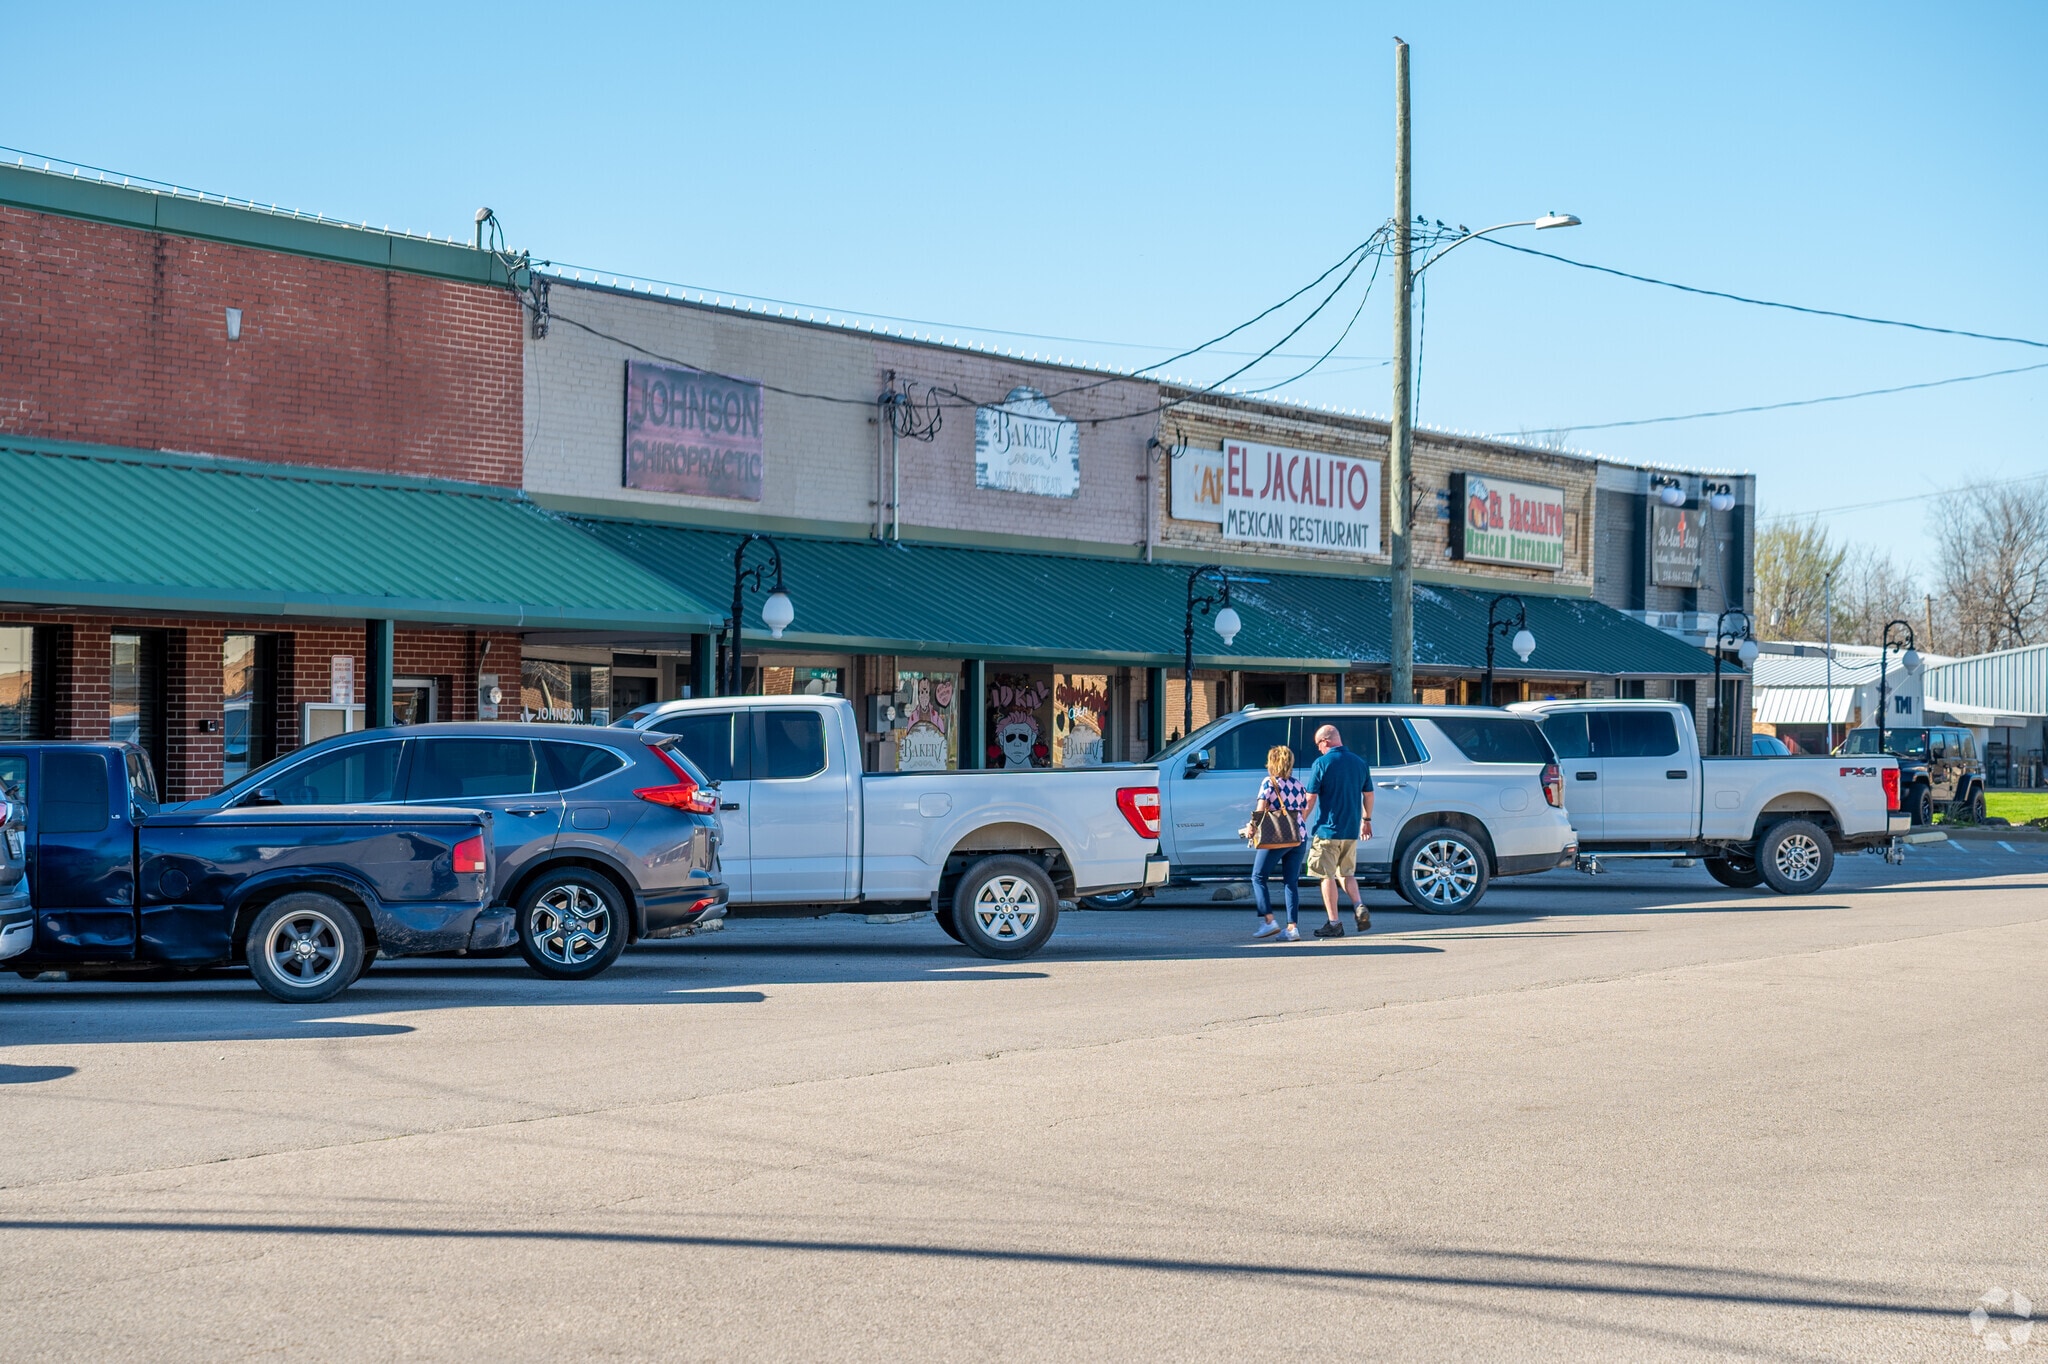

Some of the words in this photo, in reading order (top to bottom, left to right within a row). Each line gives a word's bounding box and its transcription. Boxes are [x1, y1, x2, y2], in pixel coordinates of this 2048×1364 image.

[632, 379, 759, 438] JOHNSON
[629, 440, 761, 482] CHIROPRACTIC
[1228, 446, 1253, 497] EL
[1260, 452, 1368, 511] JACALITO
[1227, 509, 1283, 540] MEXICAN
[1290, 516, 1369, 548] RESTAURANT
[1489, 490, 1503, 529] EL
[1509, 493, 1562, 537] JACALITO
[1466, 528, 1506, 559] MEXICAN
[1510, 534, 1562, 565] RESTAURANT
[536, 707, 584, 721] JOHNSON
[1895, 695, 1912, 715] TMI
[1840, 767, 1877, 777] FX4
